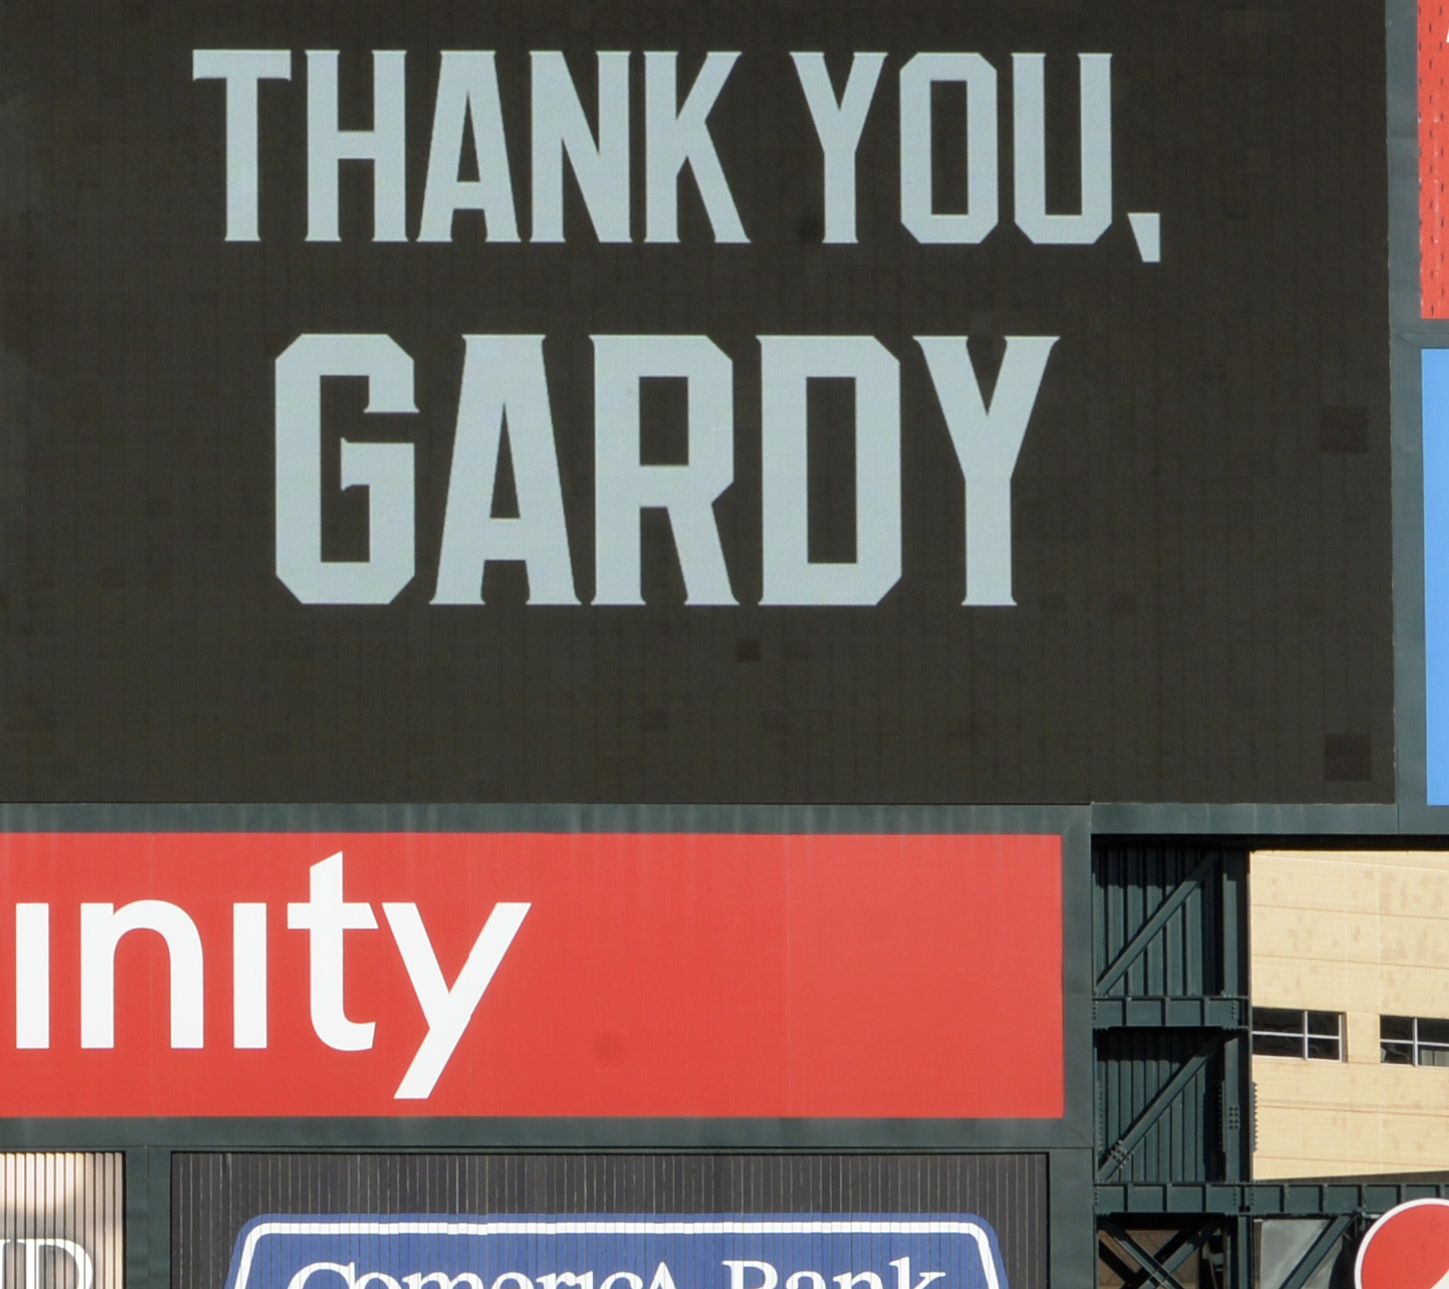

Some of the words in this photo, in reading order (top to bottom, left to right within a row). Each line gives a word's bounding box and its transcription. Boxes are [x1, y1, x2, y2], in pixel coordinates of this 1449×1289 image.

[193, 49, 751, 242] THANK
[790, 52, 1161, 263] YOU,
[274, 333, 1060, 606] GARDY
